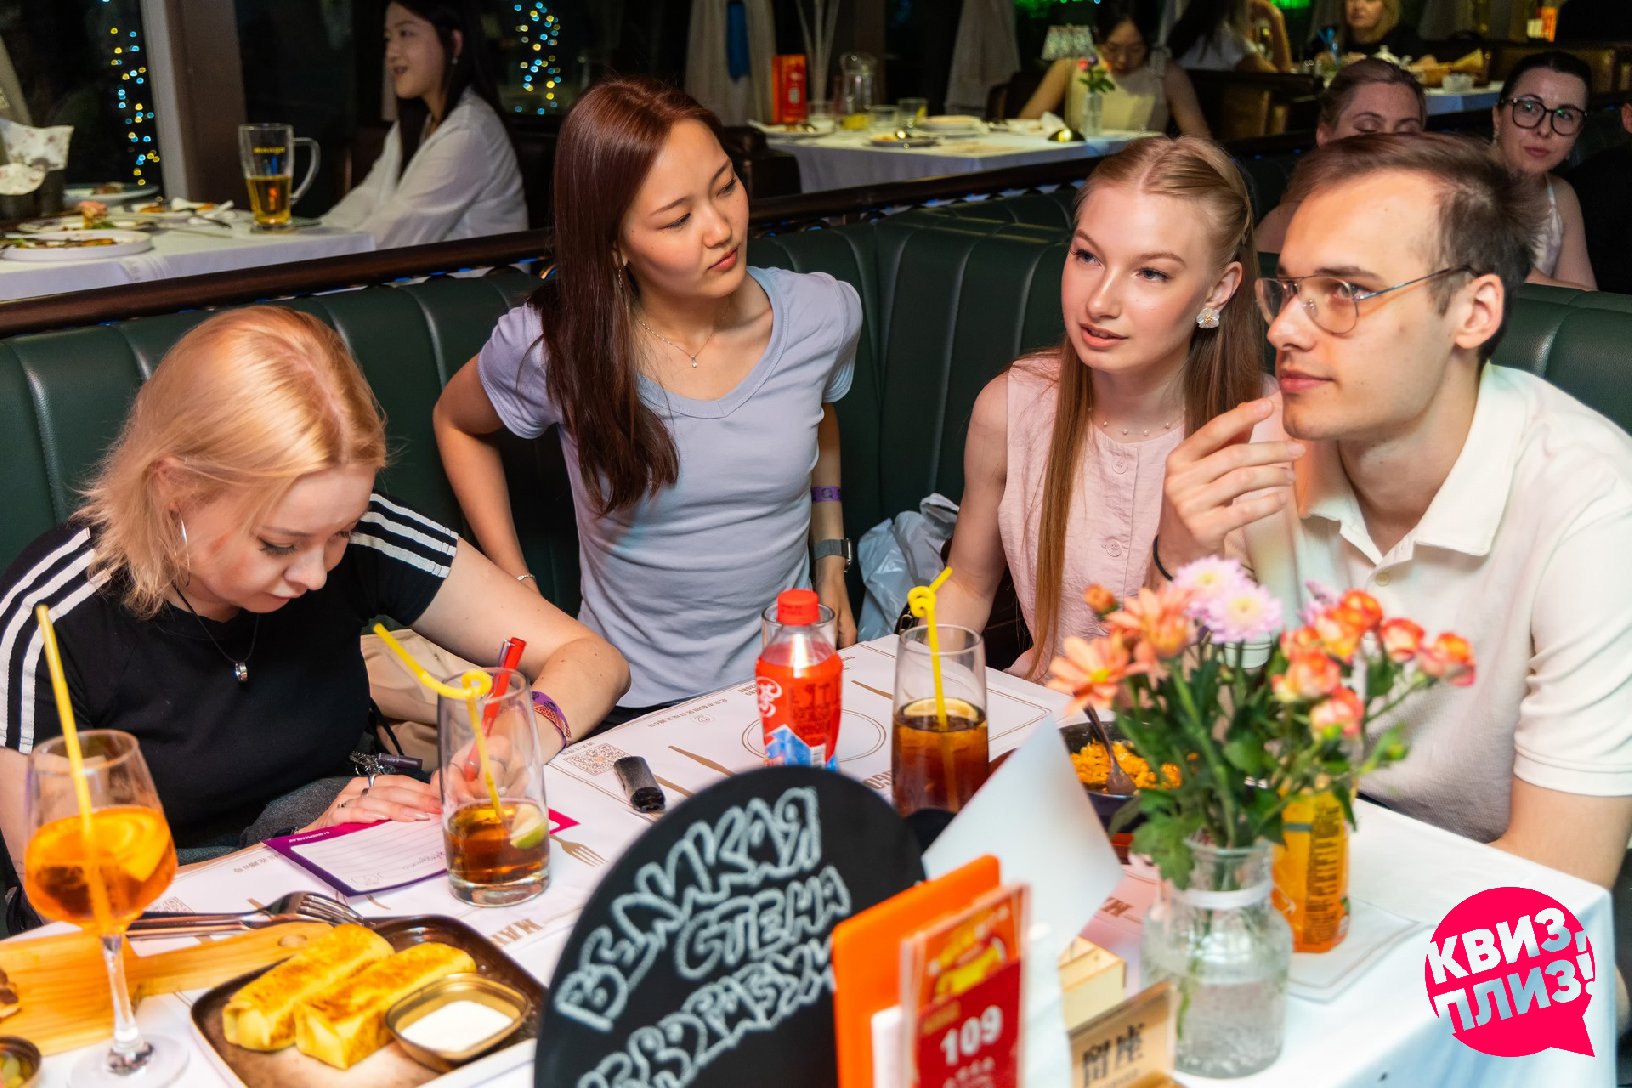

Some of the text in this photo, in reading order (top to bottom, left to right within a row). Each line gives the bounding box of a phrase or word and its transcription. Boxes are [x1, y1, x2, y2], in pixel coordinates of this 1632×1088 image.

[554, 786, 821, 1032] ВЕЛИКАЯ
[674, 865, 851, 981] СТЕНА
[940, 1005, 1003, 1066] 109
